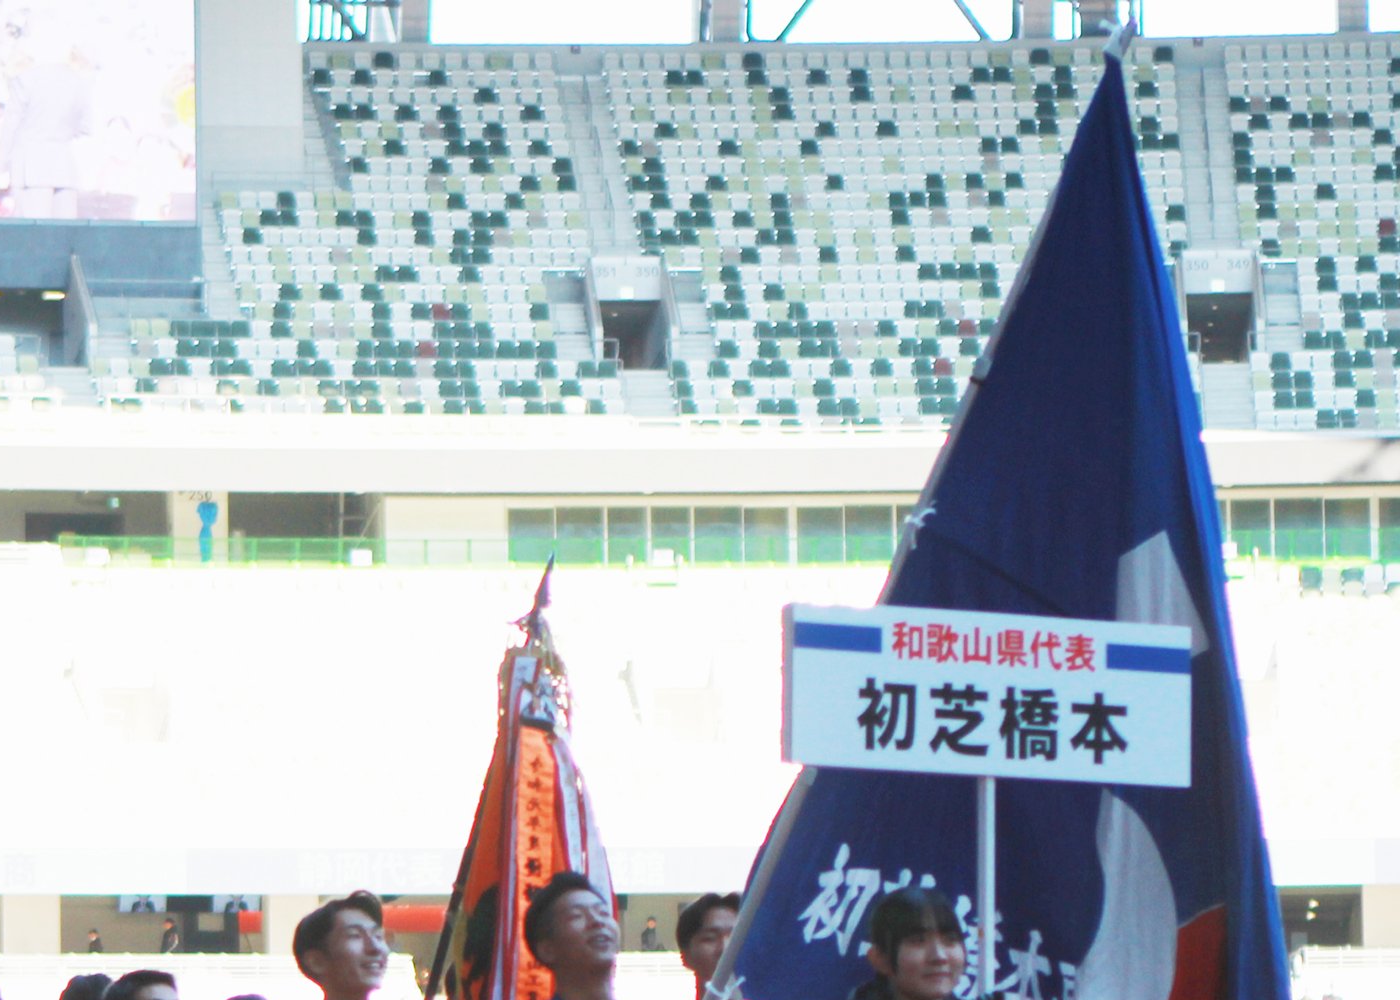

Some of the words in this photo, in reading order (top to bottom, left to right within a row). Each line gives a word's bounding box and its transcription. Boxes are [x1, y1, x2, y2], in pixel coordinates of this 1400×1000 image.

[891, 621, 1097, 673] 和歌山県代表
[856, 677, 1129, 766] 初芝橋本
